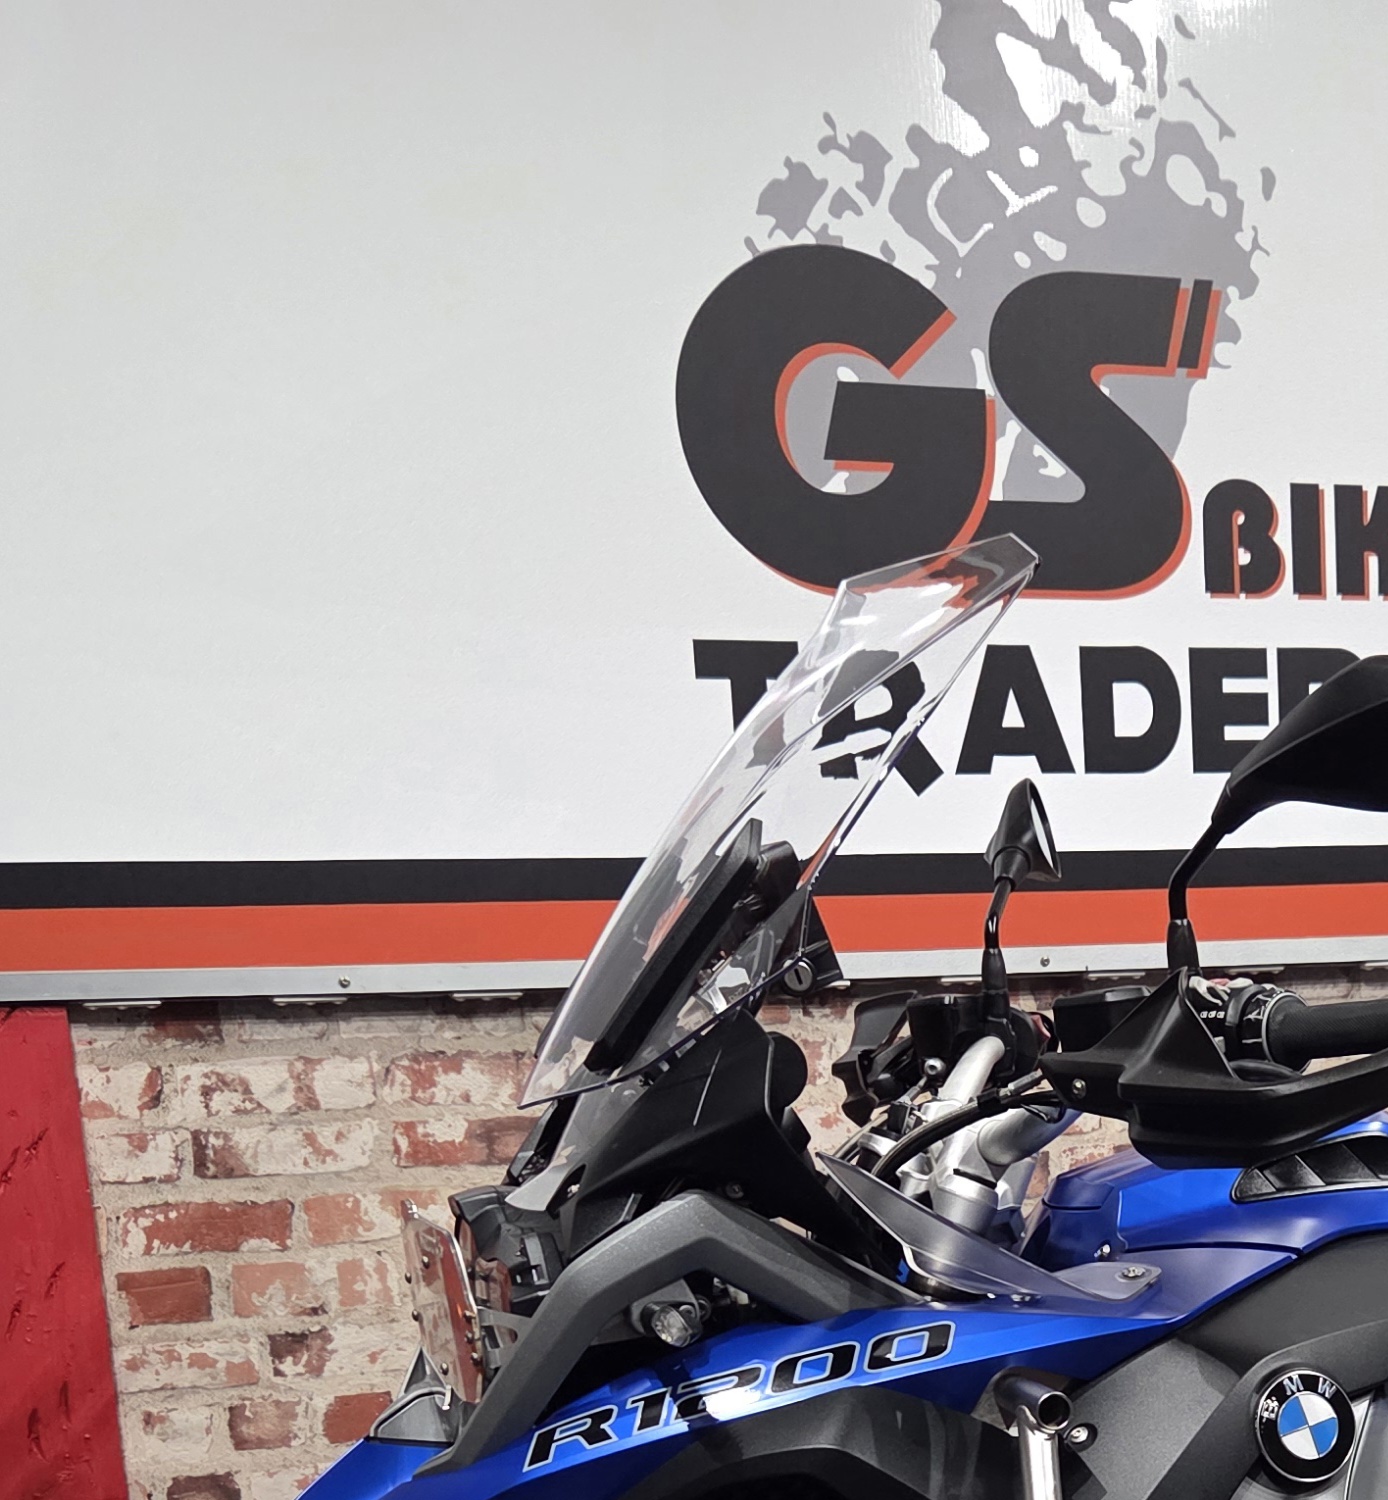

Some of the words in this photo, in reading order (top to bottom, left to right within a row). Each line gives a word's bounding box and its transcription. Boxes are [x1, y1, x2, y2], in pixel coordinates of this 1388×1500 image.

[675, 243, 1222, 601] GS
[522, 1321, 956, 1473] R1200
[1260, 1373, 1337, 1421] BMW
